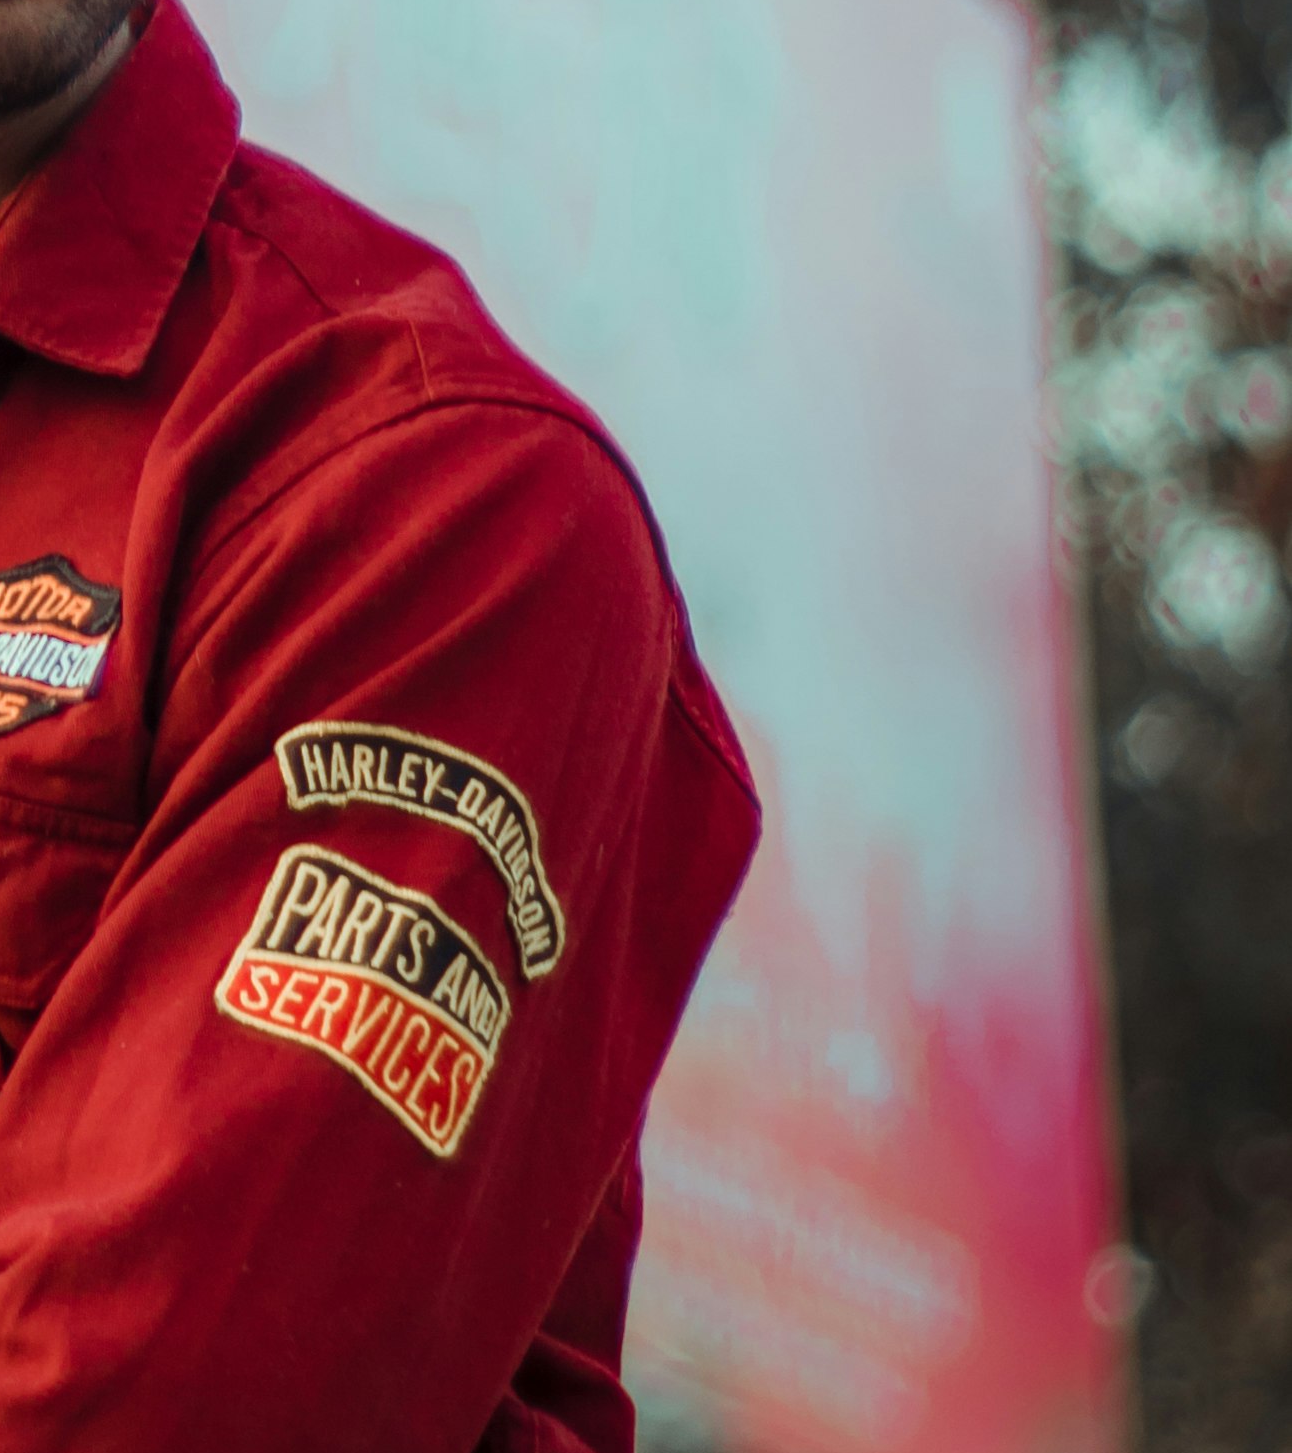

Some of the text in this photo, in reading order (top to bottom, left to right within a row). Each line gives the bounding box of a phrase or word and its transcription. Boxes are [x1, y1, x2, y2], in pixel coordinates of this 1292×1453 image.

[300, 741, 553, 966] HARLEY-DAVIDSON
[266, 861, 499, 1042] PARTS AND
[238, 964, 477, 1141] SERVICES
